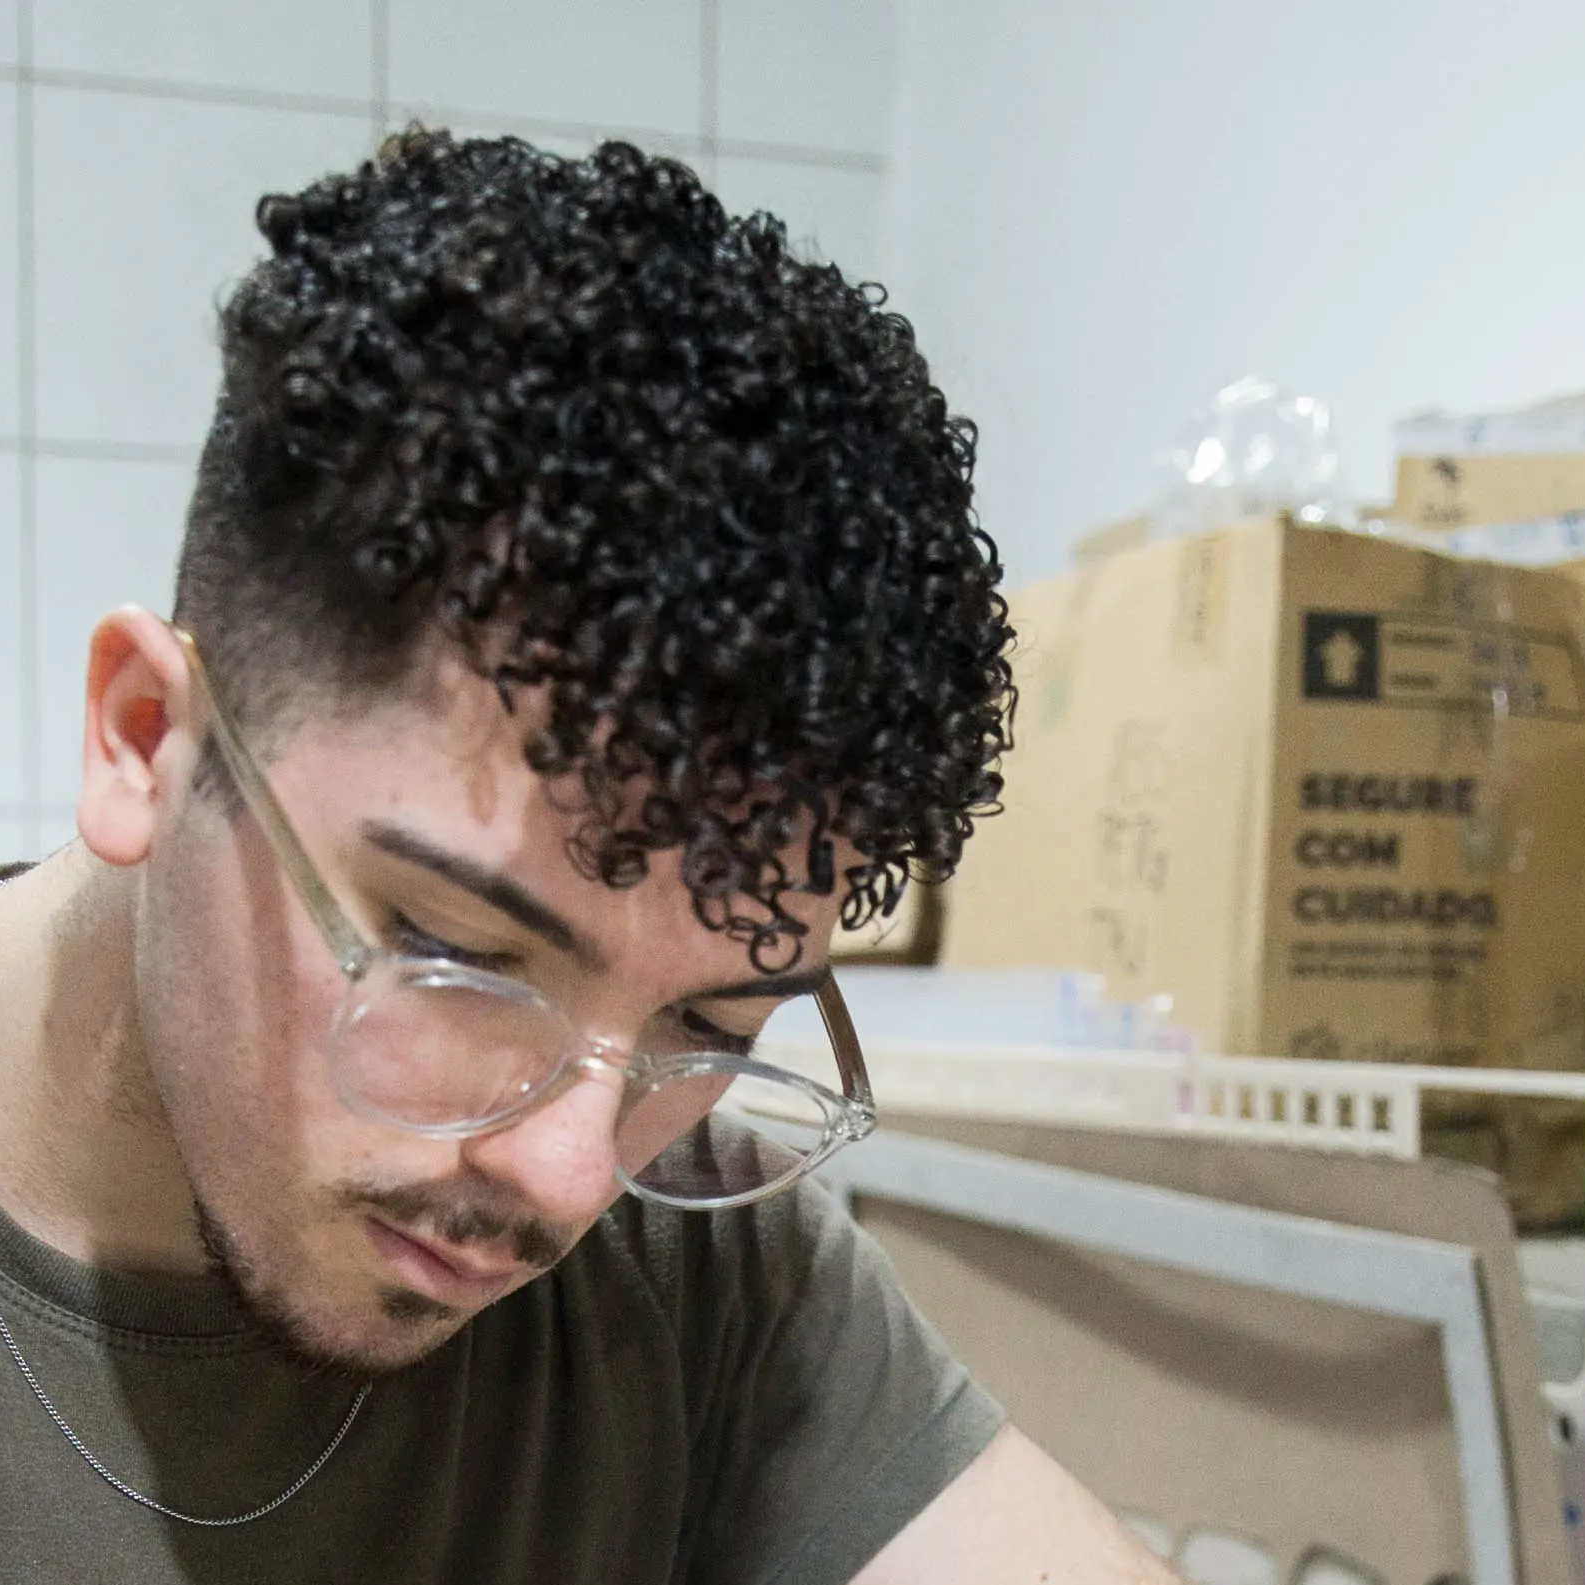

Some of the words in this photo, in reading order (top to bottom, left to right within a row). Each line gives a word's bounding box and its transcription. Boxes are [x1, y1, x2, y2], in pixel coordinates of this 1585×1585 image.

[1300, 774, 1477, 815] SEGURE
[1295, 829, 1401, 869] COM
[1292, 883, 1498, 927] CUIDADO
